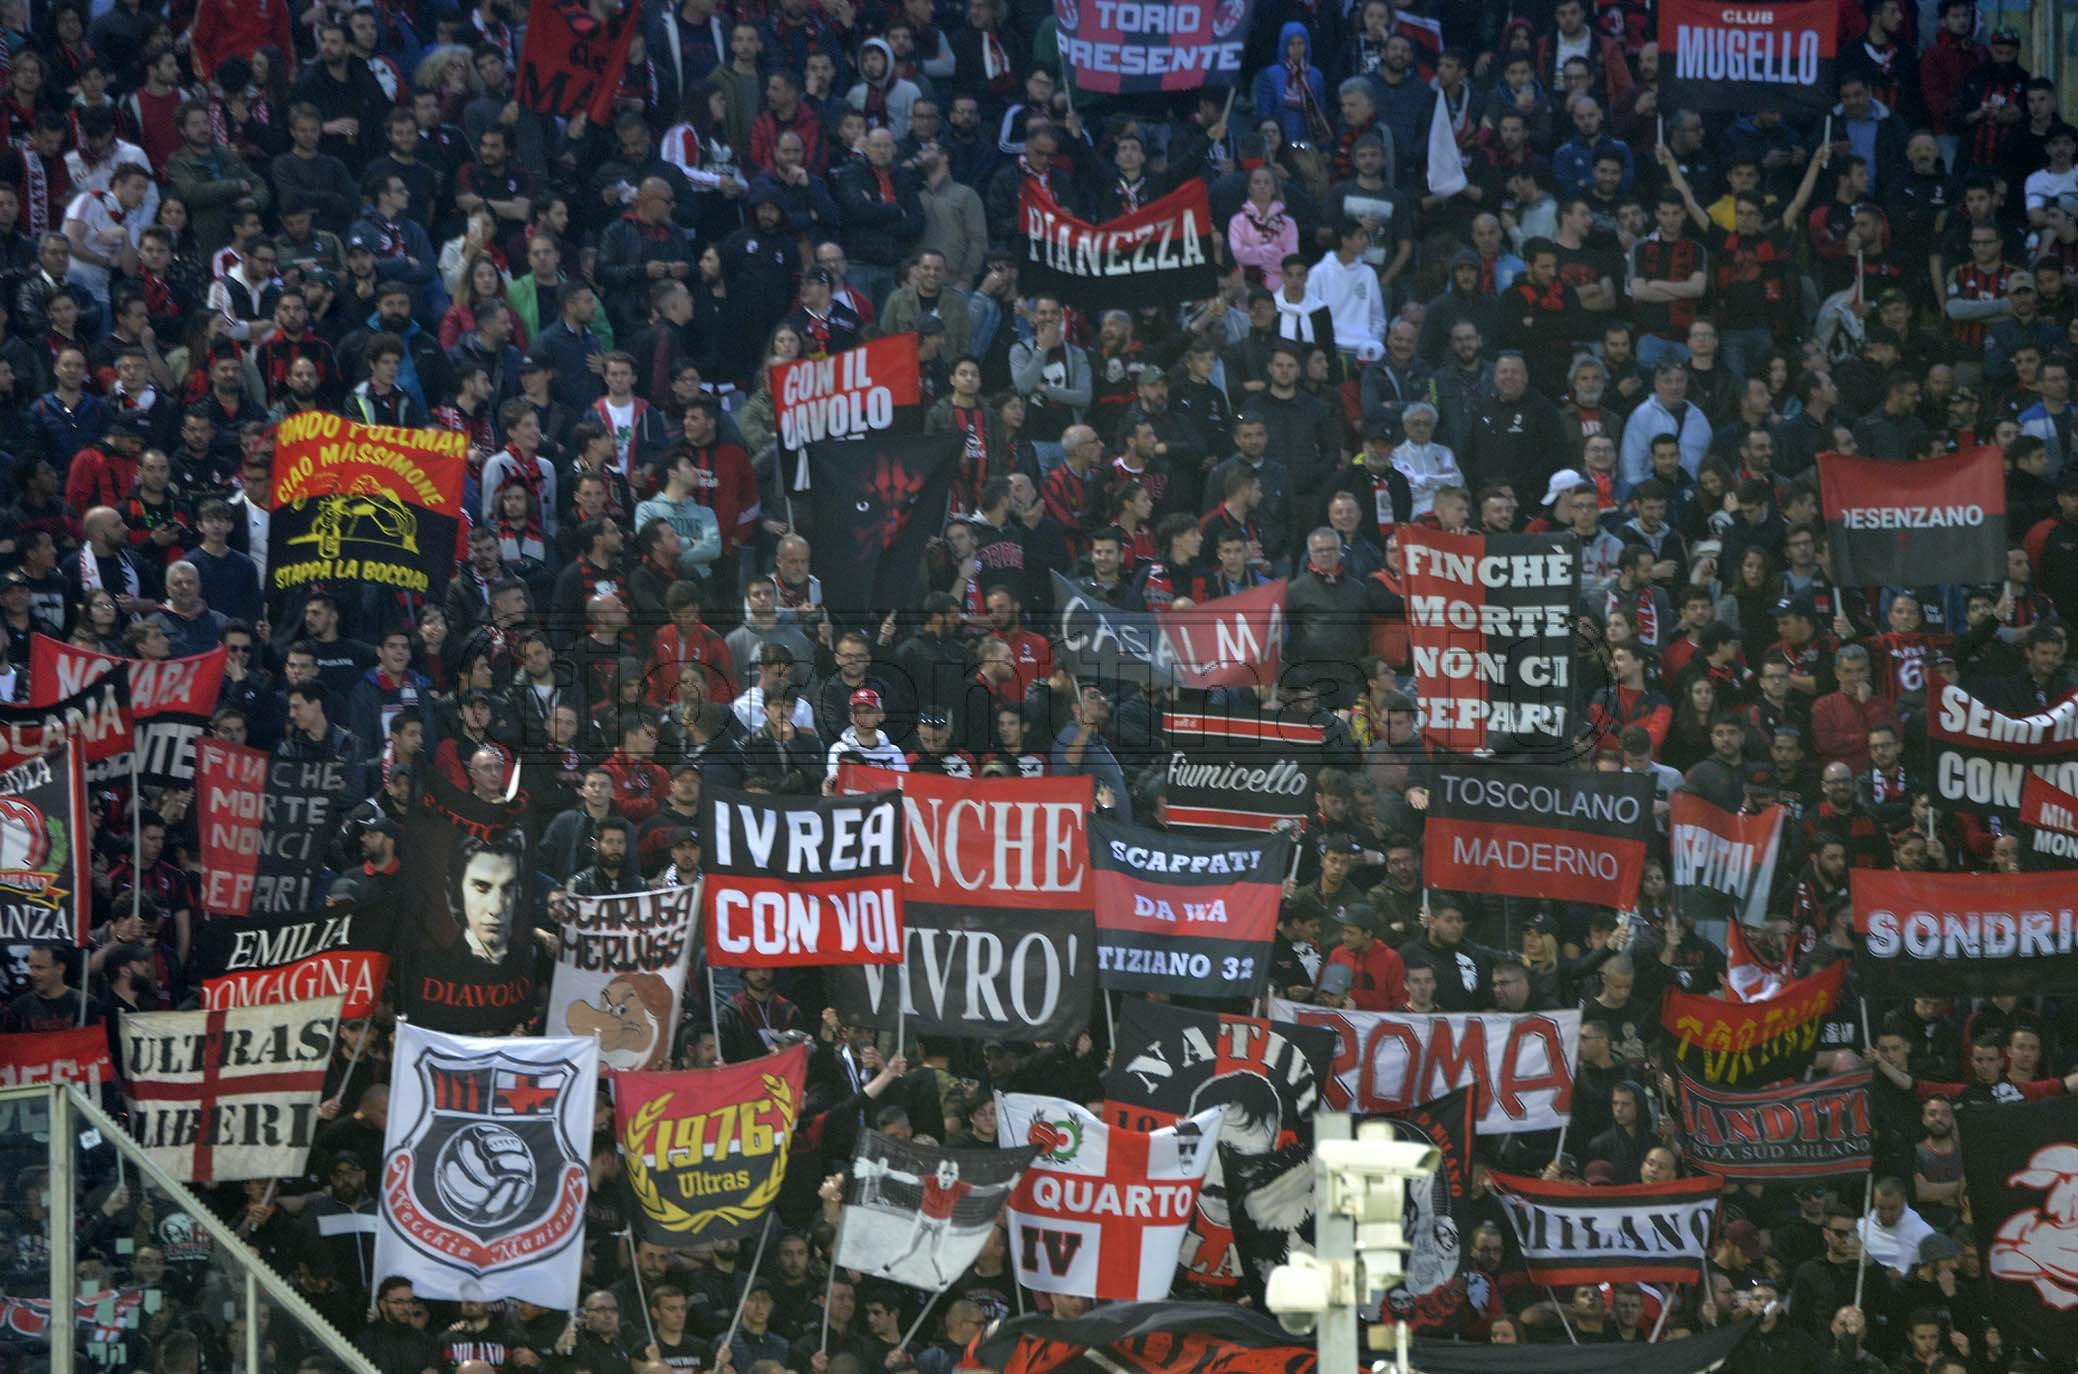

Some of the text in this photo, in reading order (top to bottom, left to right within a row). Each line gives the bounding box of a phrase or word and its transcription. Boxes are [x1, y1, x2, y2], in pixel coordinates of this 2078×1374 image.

[1722, 10, 1773, 24] CLUB
[1056, 31, 1244, 75] PRESENTE
[1676, 25, 1819, 86] MUGELLO
[1028, 206, 1205, 277] PIANEZZA
[783, 347, 872, 406] CON IL
[277, 442, 445, 506] CIAO MASSIMONE
[274, 560, 332, 589] STAPPA
[336, 560, 357, 579] LA
[1410, 595, 1570, 637] MORTE
[1413, 646, 1569, 687] NON CI
[1939, 684, 2078, 745] SEMPR
[1168, 751, 1308, 796] Fiumicello
[1938, 751, 2025, 809] CON
[209, 787, 329, 824] MORTE
[1441, 775, 1640, 824] TOSCOLANO
[714, 800, 895, 873] IVREA
[1453, 836, 1618, 880] MADERNO
[201, 867, 311, 912] EPARI
[1134, 894, 1176, 922] DA
[225, 914, 352, 970] EMILIA
[716, 888, 900, 955] CON VOI
[1866, 909, 2078, 960] SONDRI
[1097, 945, 1254, 980] TIZIANO 32
[130, 1017, 334, 1074] ULTRAS
[1283, 1009, 1574, 1122] ROMA
[135, 1103, 313, 1149] LIBERI
[655, 1099, 774, 1172] 1976
[1680, 1087, 1873, 1148] ANDITI
[677, 1170, 750, 1198] Ultras
[1033, 1176, 1193, 1218] QUARTO
[1021, 1226, 1083, 1277] IV
